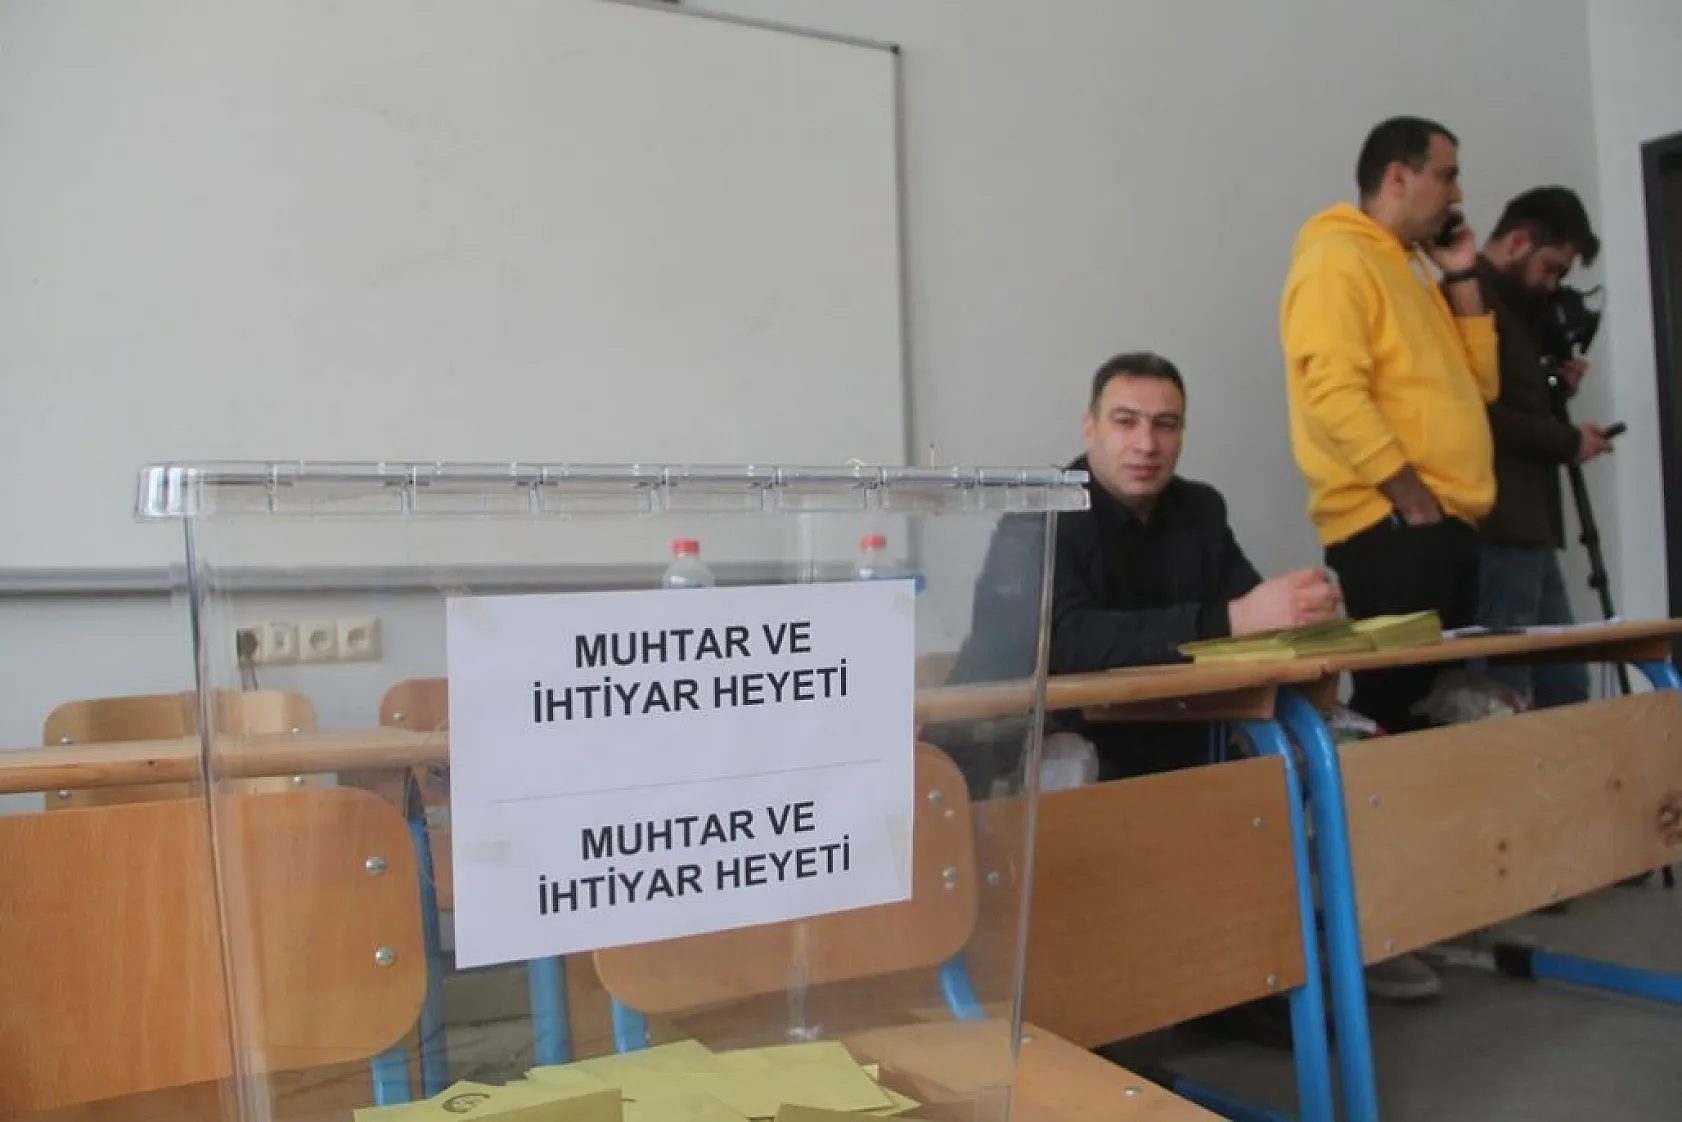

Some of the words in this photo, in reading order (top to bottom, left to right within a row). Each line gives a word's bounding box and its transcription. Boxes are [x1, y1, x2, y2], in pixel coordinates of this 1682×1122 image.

[575, 625, 752, 669] MUHTAR
[762, 621, 812, 655] VE
[533, 676, 700, 724] İHTİYAR
[713, 658, 848, 709] HEYETİ
[581, 809, 755, 861] MUHTAR
[766, 800, 816, 835] VE
[538, 863, 703, 915] İHTİYAR
[717, 834, 851, 891] HEYETİ
